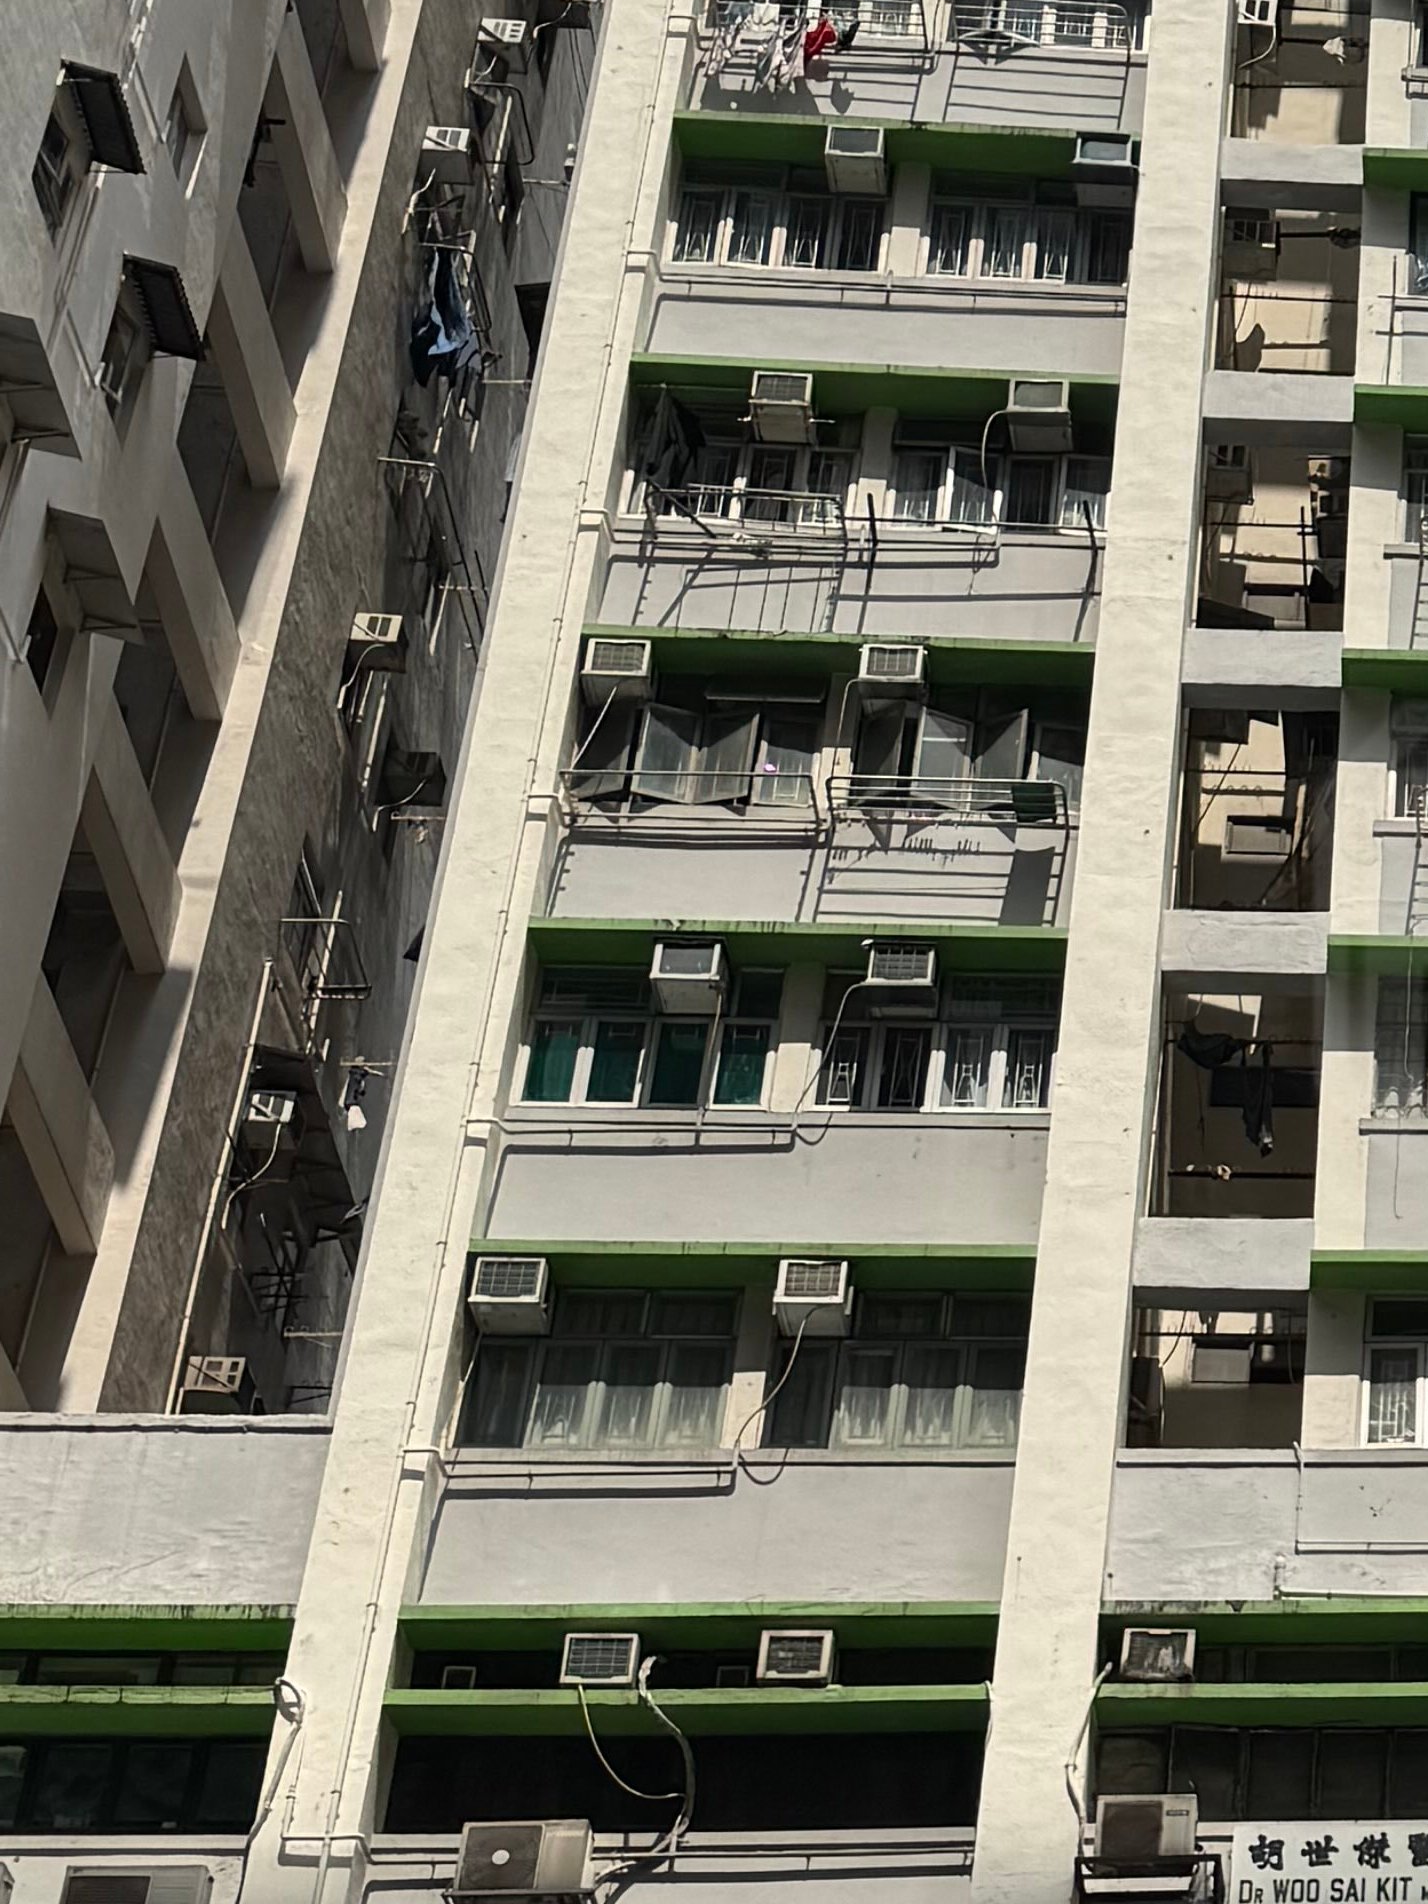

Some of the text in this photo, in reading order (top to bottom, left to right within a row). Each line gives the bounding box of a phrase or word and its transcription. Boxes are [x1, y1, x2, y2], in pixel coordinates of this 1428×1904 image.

[1273, 1878, 1320, 1903] WOO
[1330, 1877, 1366, 1902] SAI
[1377, 1876, 1412, 1902] KIT
